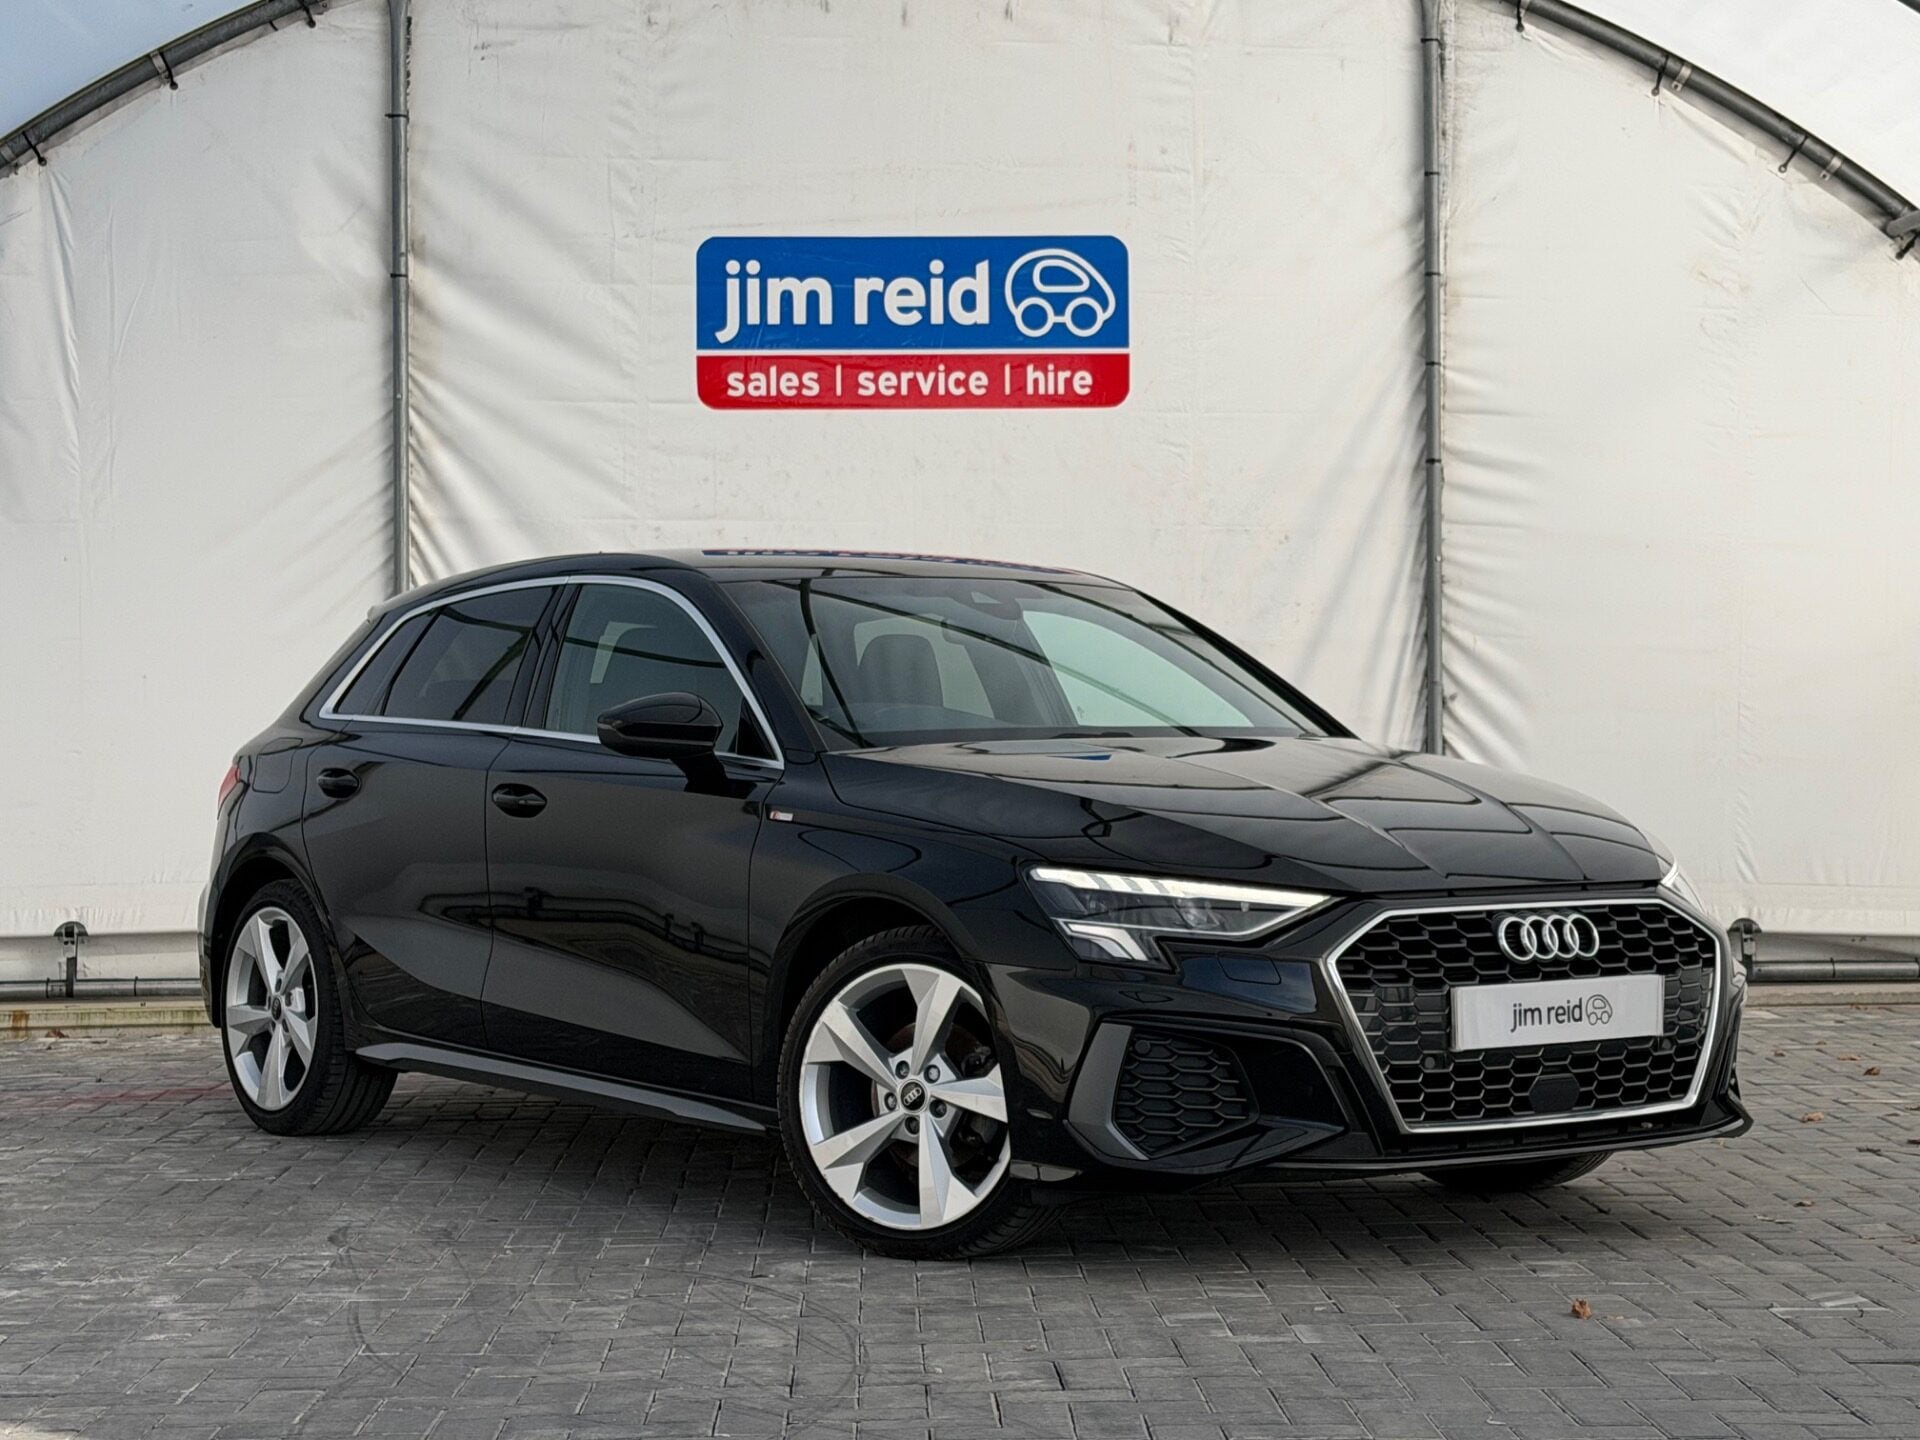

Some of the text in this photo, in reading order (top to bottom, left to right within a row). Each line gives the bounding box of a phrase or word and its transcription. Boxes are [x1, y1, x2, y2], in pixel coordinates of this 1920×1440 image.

[714, 259, 990, 344] jim reid
[726, 364, 1094, 397] sales service hire
[1510, 997, 1583, 1033] jim reid
